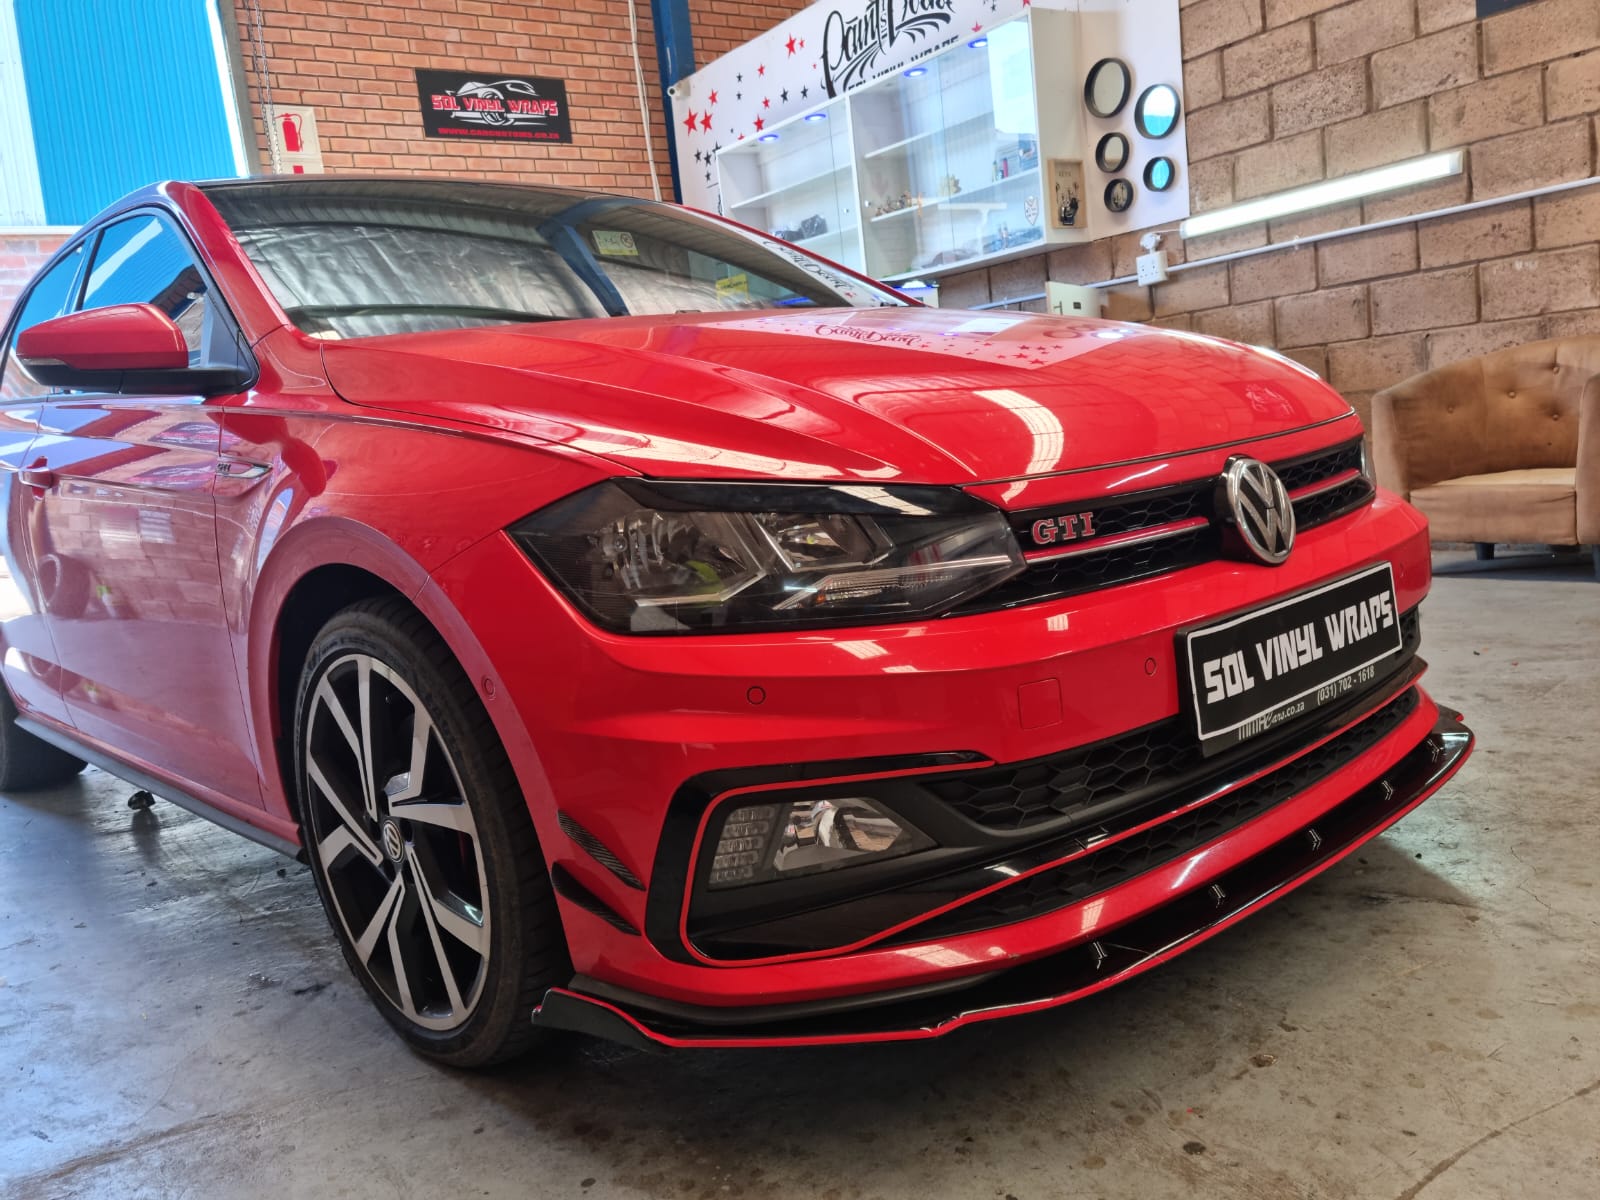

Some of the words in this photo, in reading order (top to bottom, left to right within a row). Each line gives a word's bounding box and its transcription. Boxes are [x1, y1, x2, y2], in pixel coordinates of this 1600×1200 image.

[431, 95, 461, 110] SOL
[462, 97, 505, 112] VINYL
[507, 100, 559, 116] WRAPS
[1032, 511, 1096, 545] GTI
[1202, 650, 1255, 704] SOL
[1255, 622, 1323, 681] VINYL
[1324, 590, 1394, 652] WRAPS
[1317, 683, 1337, 706] (031)
[1339, 675, 1352, 693] 702
[1358, 665, 1375, 683] 1618
